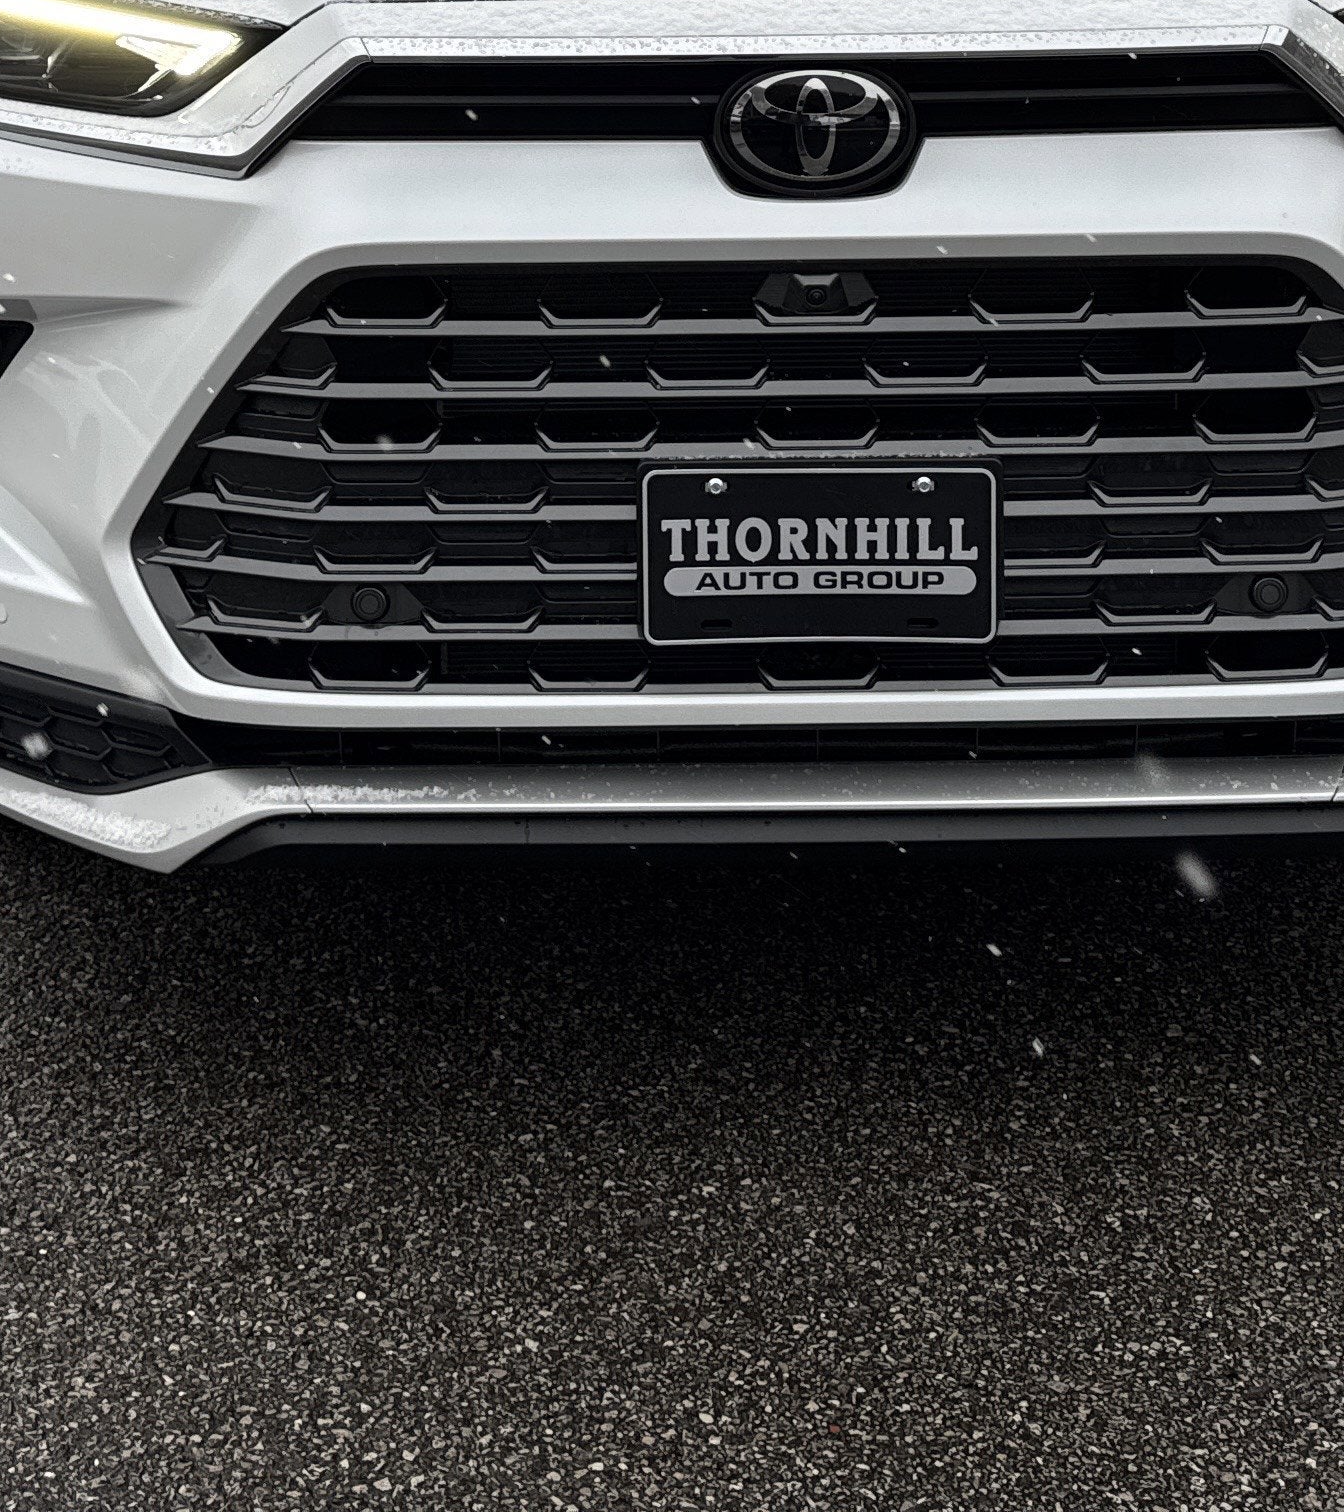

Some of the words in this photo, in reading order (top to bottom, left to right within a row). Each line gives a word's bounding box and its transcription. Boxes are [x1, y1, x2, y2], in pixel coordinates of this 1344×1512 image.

[661, 516, 979, 563] THORNHILL
[695, 571, 799, 591] AUTO
[813, 570, 944, 590] GROUP
